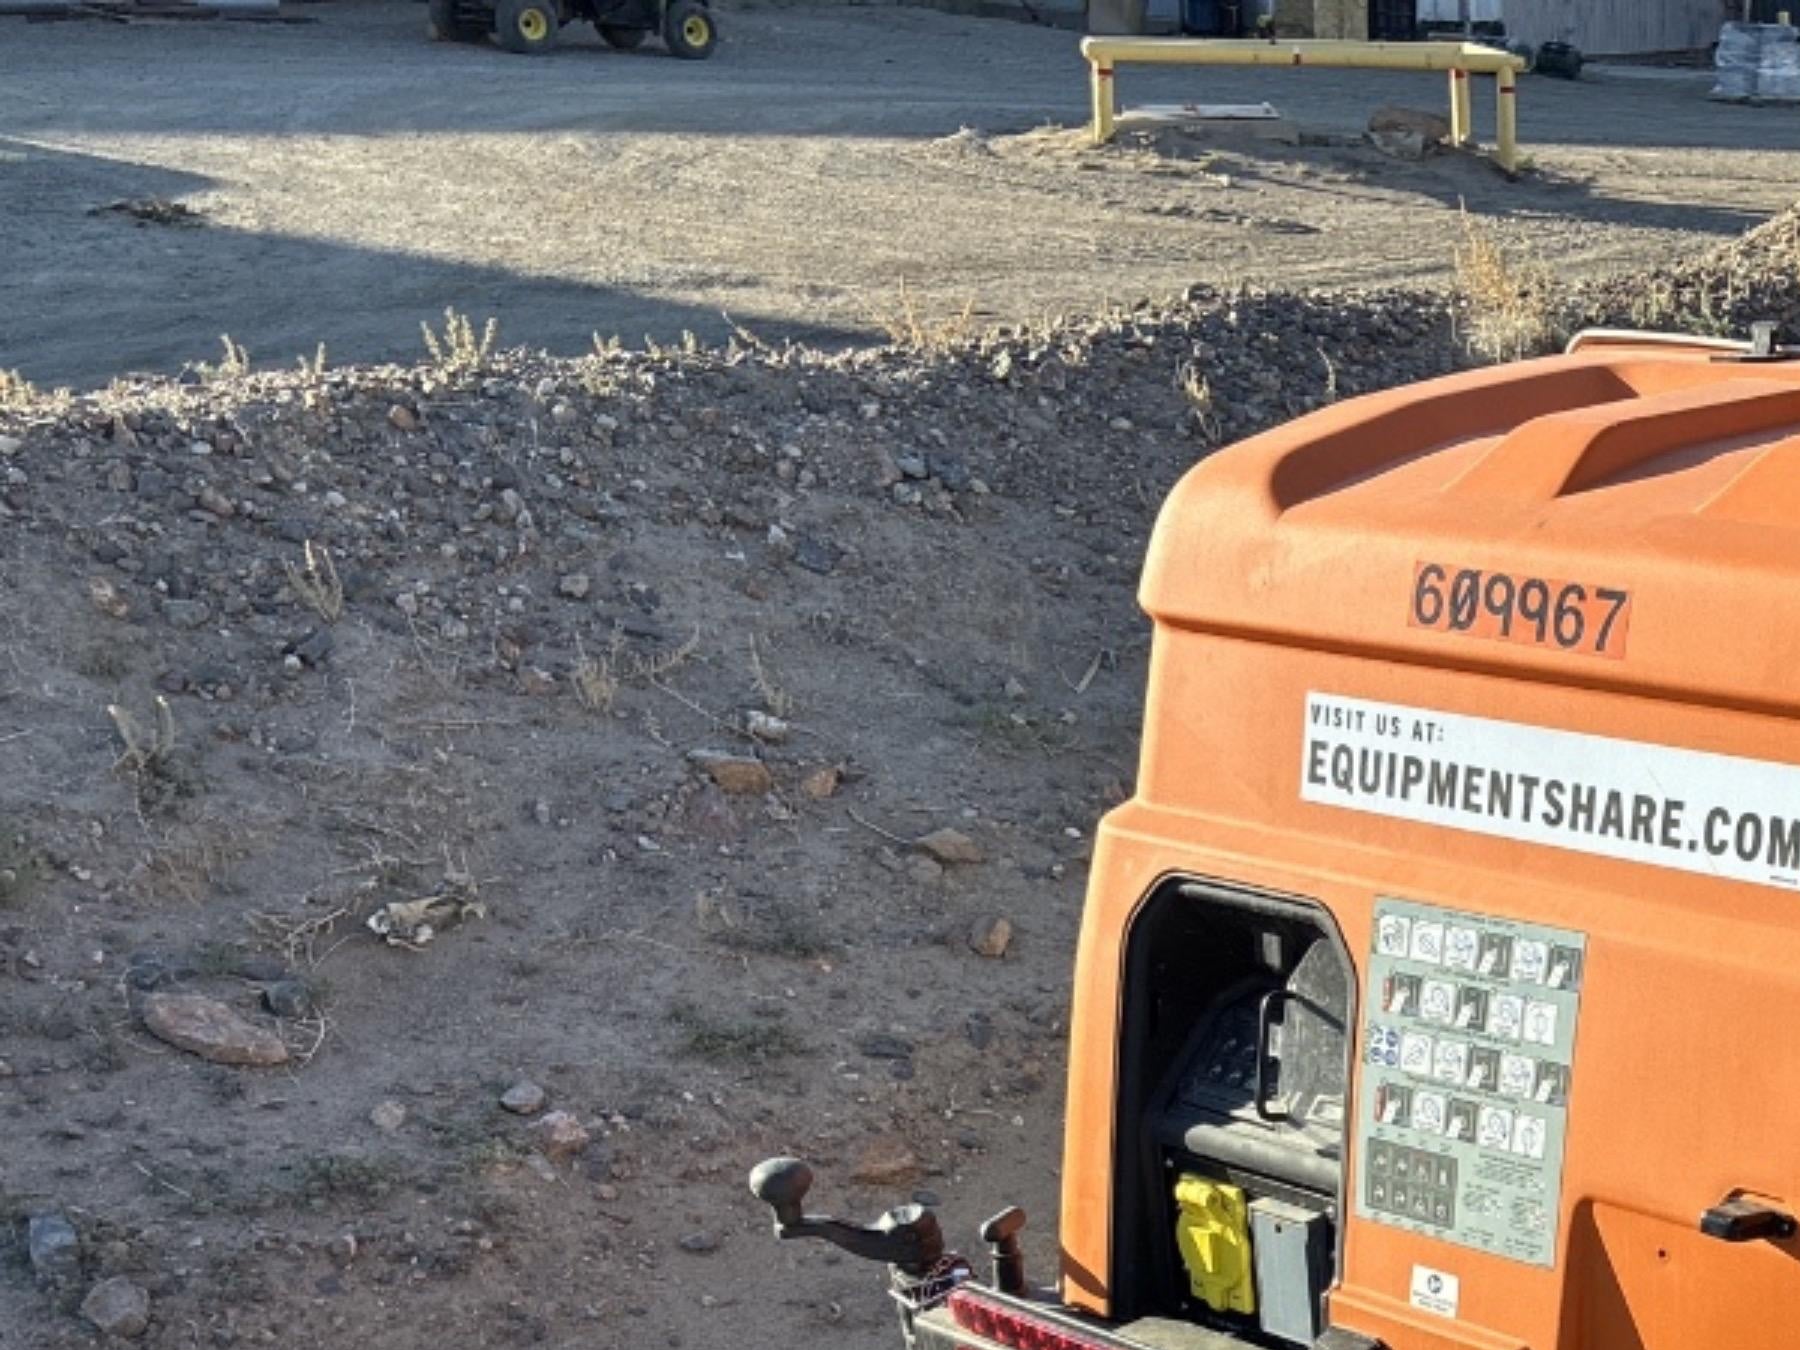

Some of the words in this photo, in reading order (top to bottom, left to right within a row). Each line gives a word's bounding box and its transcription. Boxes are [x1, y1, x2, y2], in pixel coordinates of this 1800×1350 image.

[1413, 562, 1628, 652] 609967
[1310, 703, 1365, 732] VISIT
[1376, 713, 1401, 737] US
[1411, 719, 1444, 744] AT:
